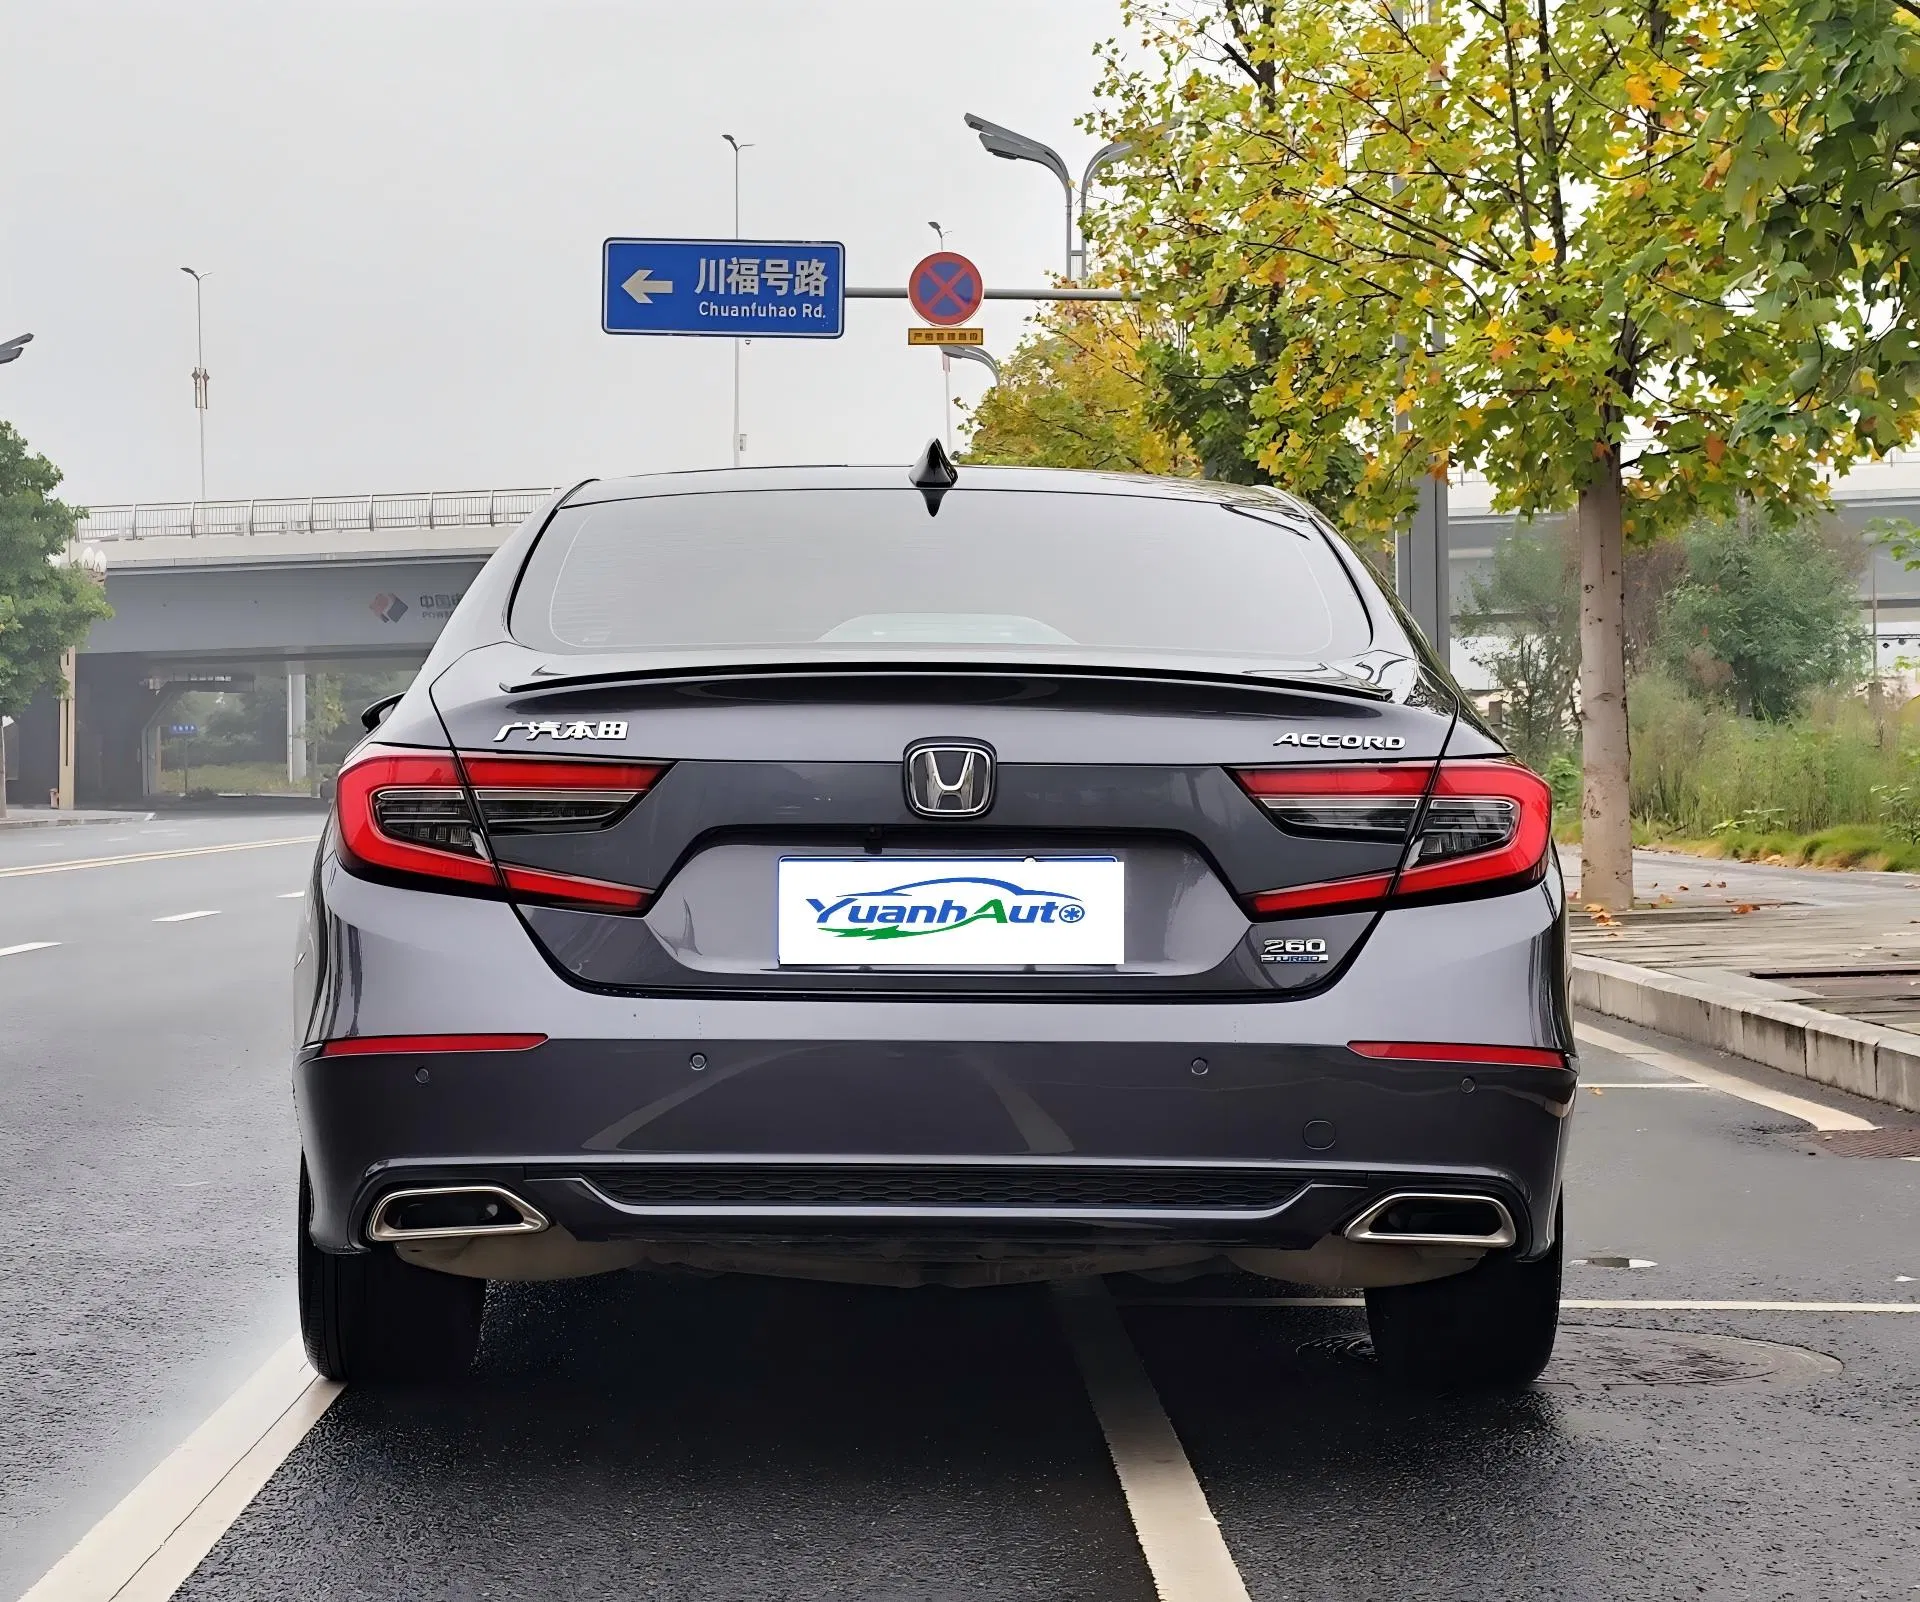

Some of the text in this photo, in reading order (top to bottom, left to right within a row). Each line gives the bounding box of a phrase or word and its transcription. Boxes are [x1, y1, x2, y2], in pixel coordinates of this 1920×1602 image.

[694, 257, 828, 297] 川福号路
[699, 301, 826, 318] Chuanfuhao Rd.
[493, 721, 628, 741] 广汽本田
[1273, 732, 1406, 750] ACCORD
[1263, 938, 1326, 953] 260
